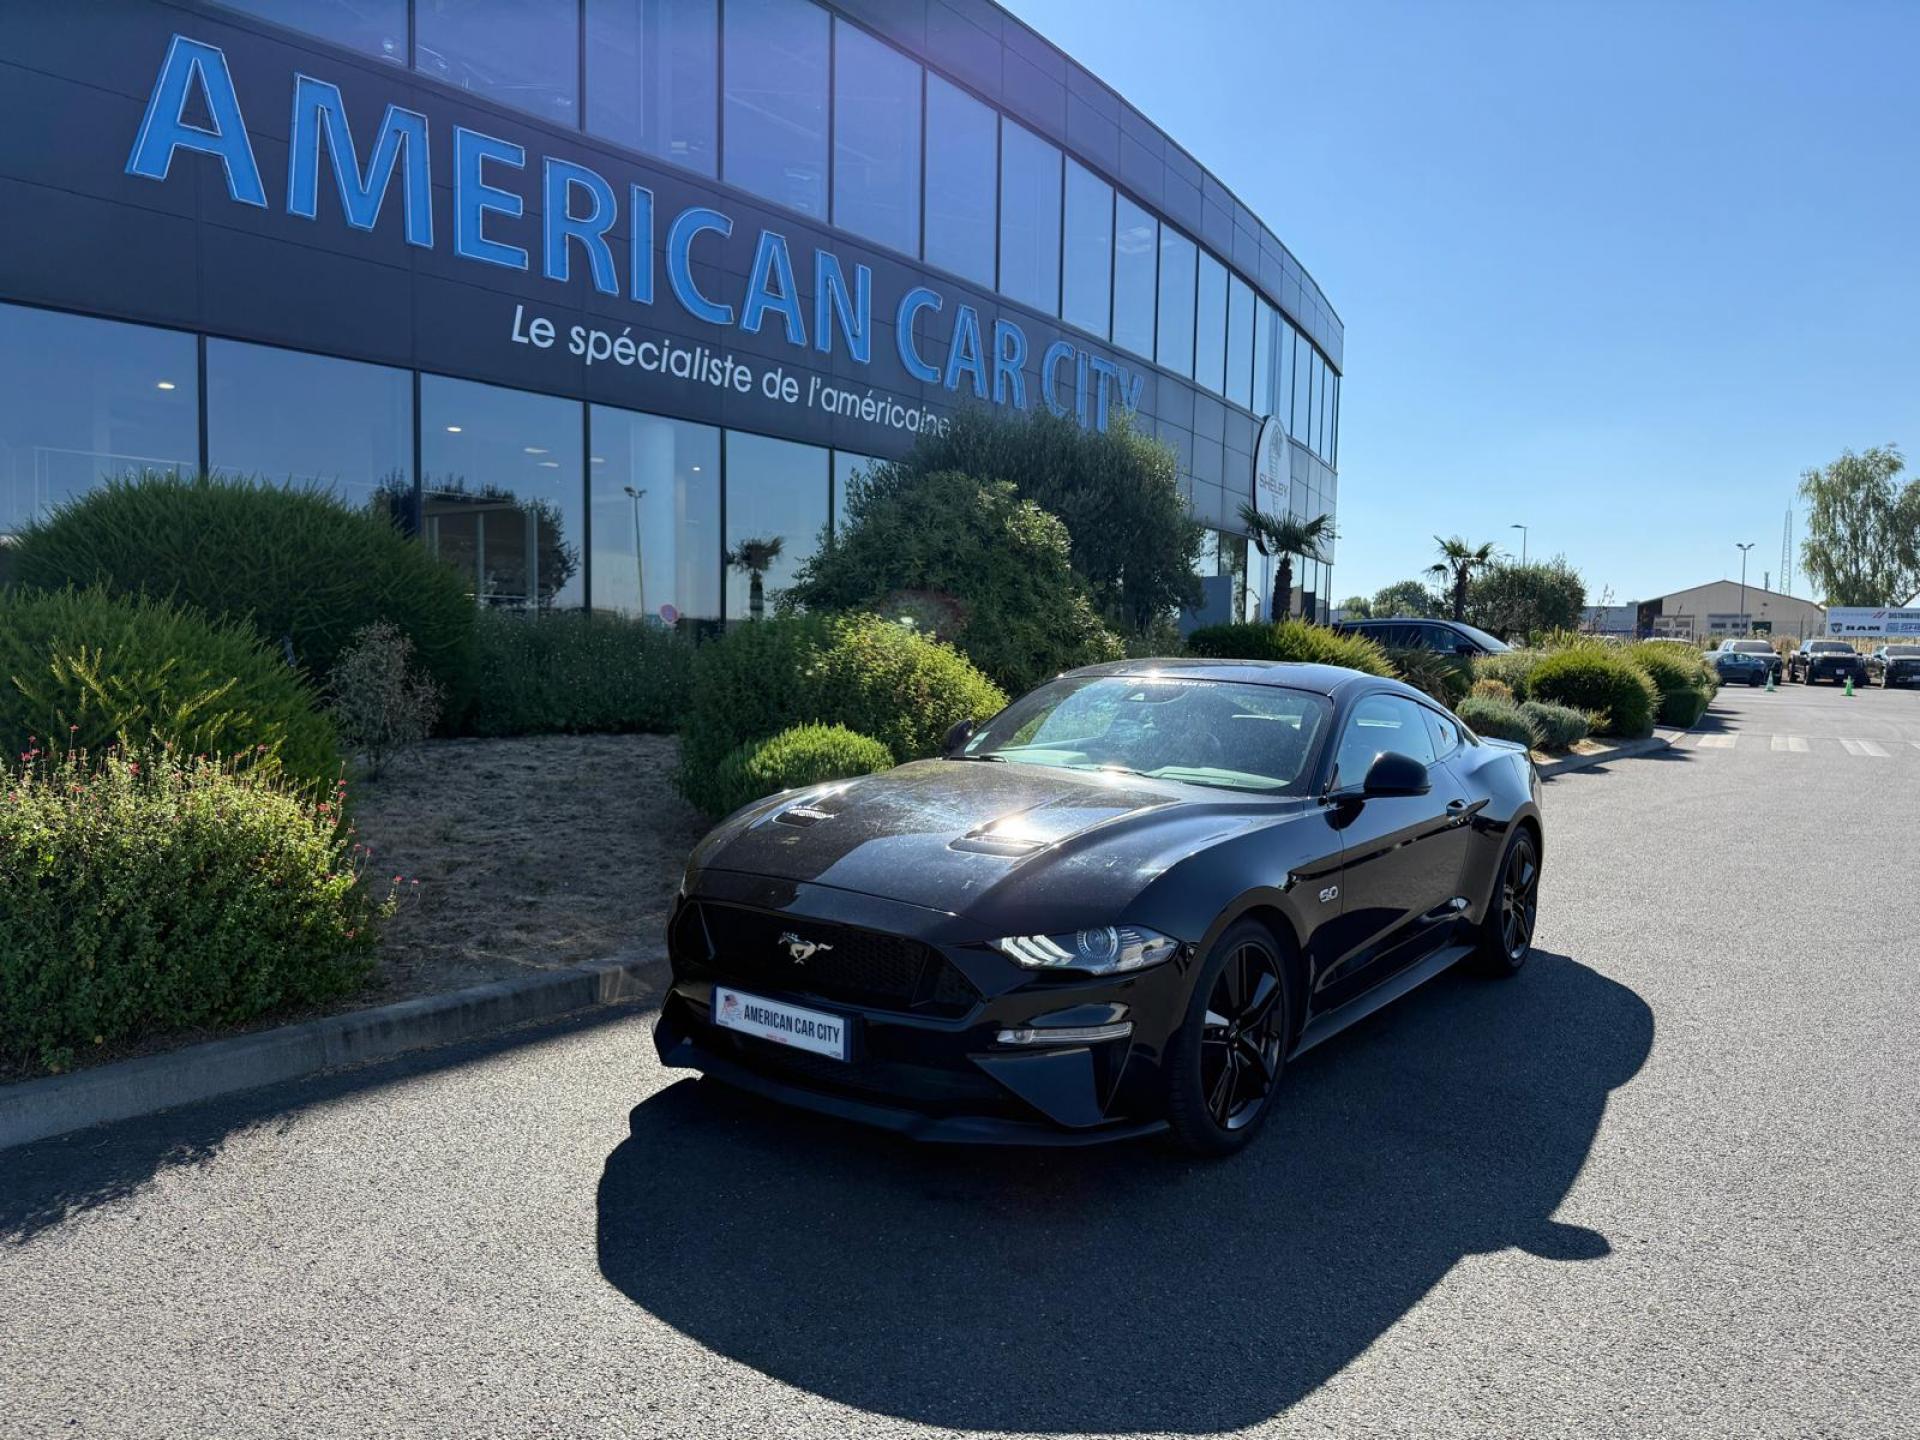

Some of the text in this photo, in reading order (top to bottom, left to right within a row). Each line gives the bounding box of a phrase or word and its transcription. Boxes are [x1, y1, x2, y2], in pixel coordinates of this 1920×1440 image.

[124, 33, 1145, 433] AMERICAN CAR CITY
[511, 304, 556, 348] Le
[568, 327, 752, 393] spécialiste
[762, 367, 799, 403] de
[743, 1004, 793, 1033] AMERICAN
[794, 1017, 816, 1039] CAR
[816, 1022, 840, 1044] CITY
